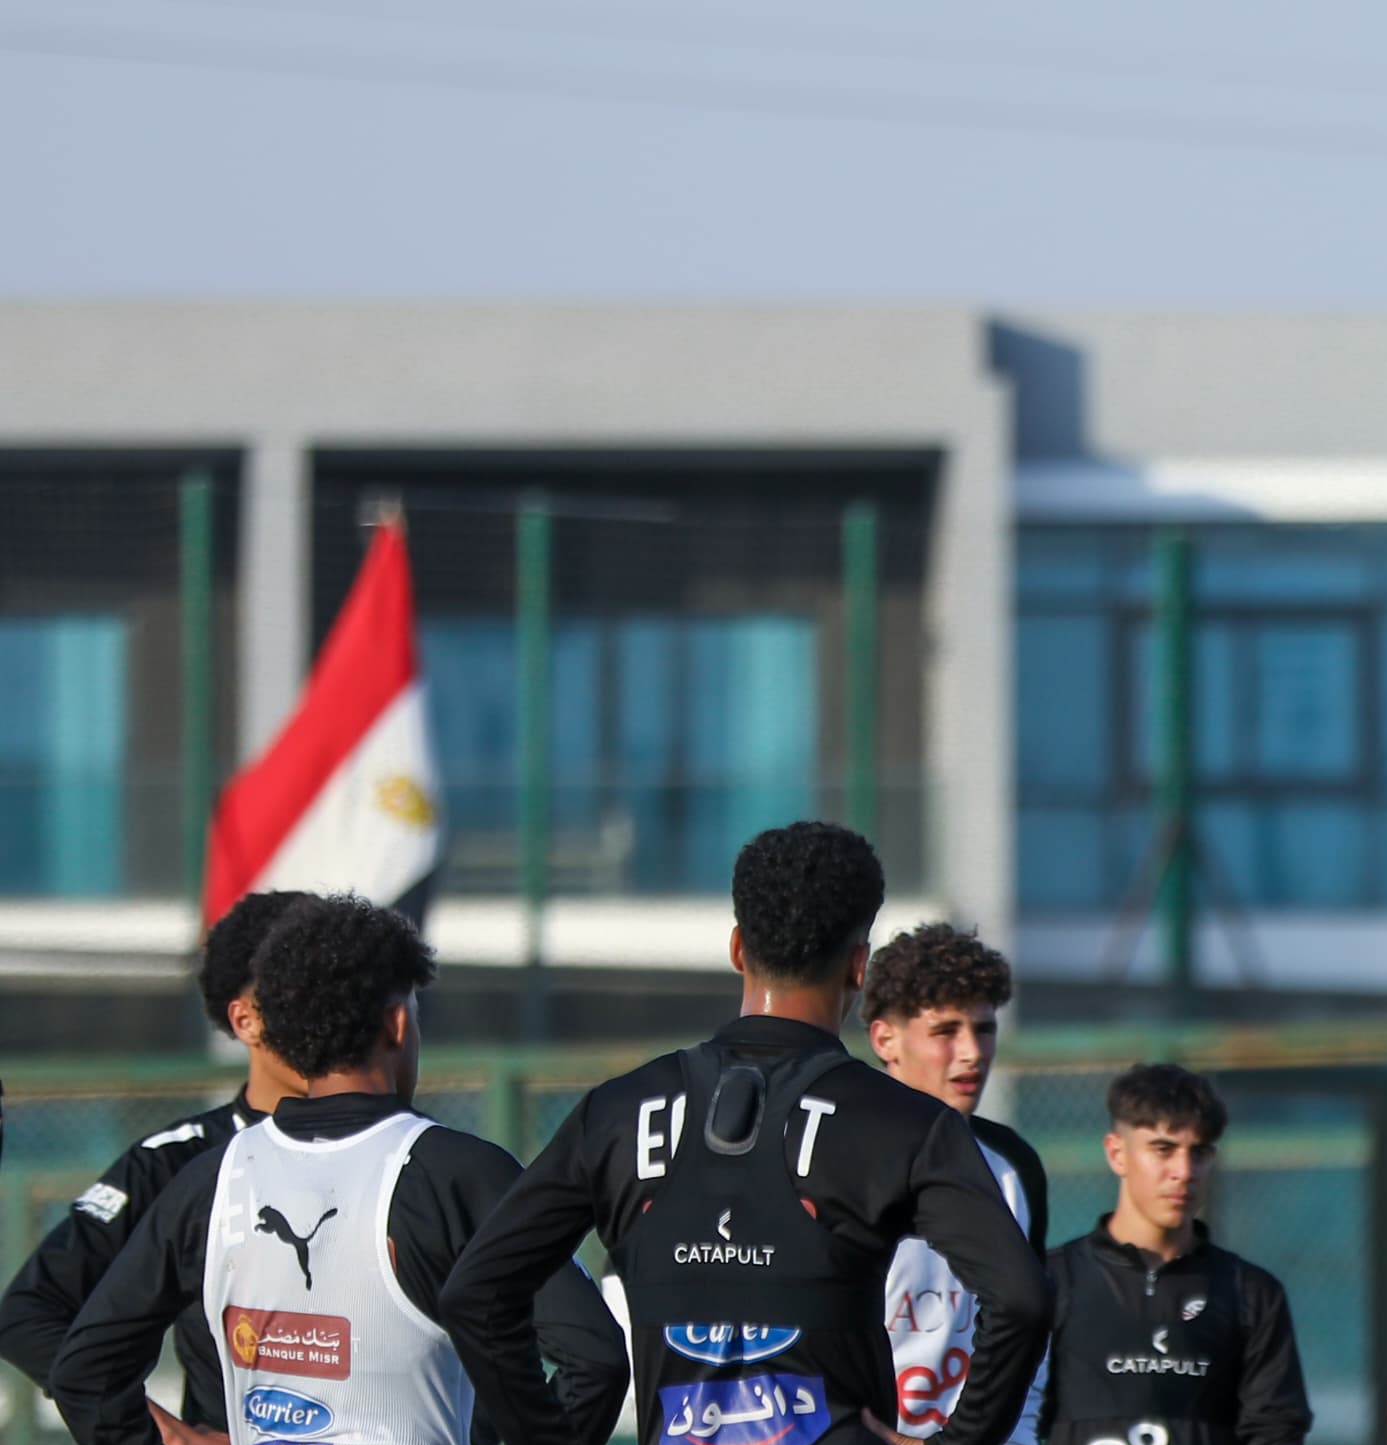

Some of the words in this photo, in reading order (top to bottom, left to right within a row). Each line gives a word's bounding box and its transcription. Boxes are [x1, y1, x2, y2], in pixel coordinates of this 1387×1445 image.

[673, 1244, 775, 1266] CATAPULT
[258, 1345, 304, 1361] BANQUE
[309, 1351, 340, 1365] MISR
[1106, 1358, 1211, 1377] CATAPULT
[247, 1395, 319, 1426] Carrier
[667, 1384, 816, 1438] دانون
